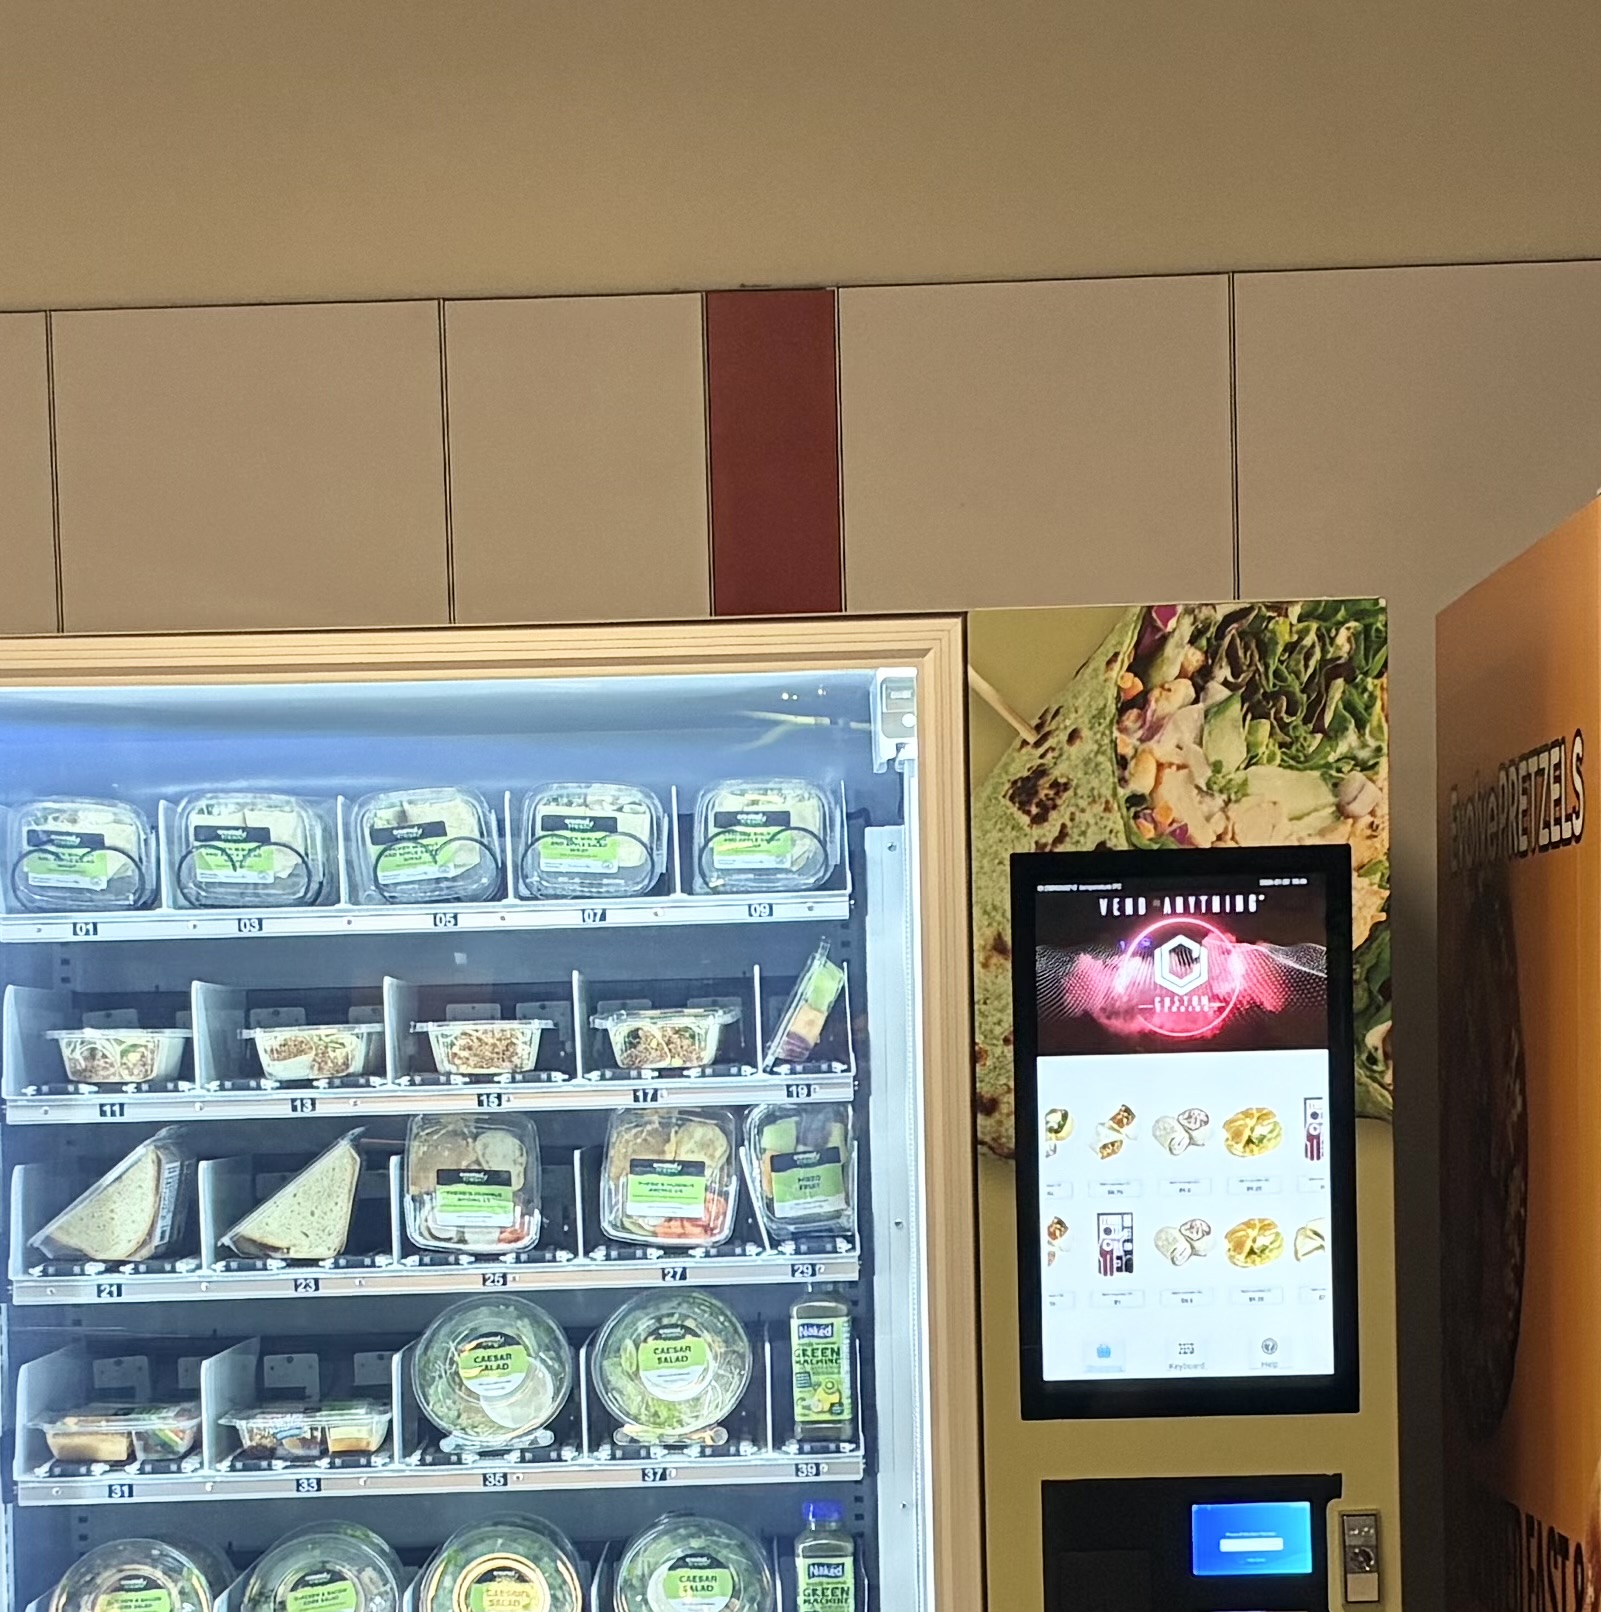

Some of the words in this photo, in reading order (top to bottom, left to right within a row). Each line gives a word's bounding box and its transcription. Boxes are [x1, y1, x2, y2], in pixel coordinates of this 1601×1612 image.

[584, 910, 602, 923] 07
[750, 904, 769, 918] 09
[241, 919, 260, 932] 03
[436, 913, 456, 927] 05
[75, 922, 95, 936] 01
[636, 1089, 654, 1102] 17
[789, 1084, 807, 1097] 19
[293, 1100, 313, 1112] 13
[480, 1094, 499, 1108] 15
[102, 1104, 122, 1117] 11
[665, 1269, 684, 1281] 27
[100, 1285, 119, 1297] 21
[297, 1280, 316, 1292] 23
[653, 1345, 691, 1355] CAESAR
[473, 1353, 512, 1363] CAESAR
[657, 1355, 688, 1365] SALAD
[644, 1469, 662, 1481] 37
[797, 1464, 817, 1476] 39
[299, 1479, 318, 1491] 33
[485, 1473, 504, 1486] 35
[112, 1485, 130, 1497] 31
[679, 1575, 717, 1583] CAESAR
